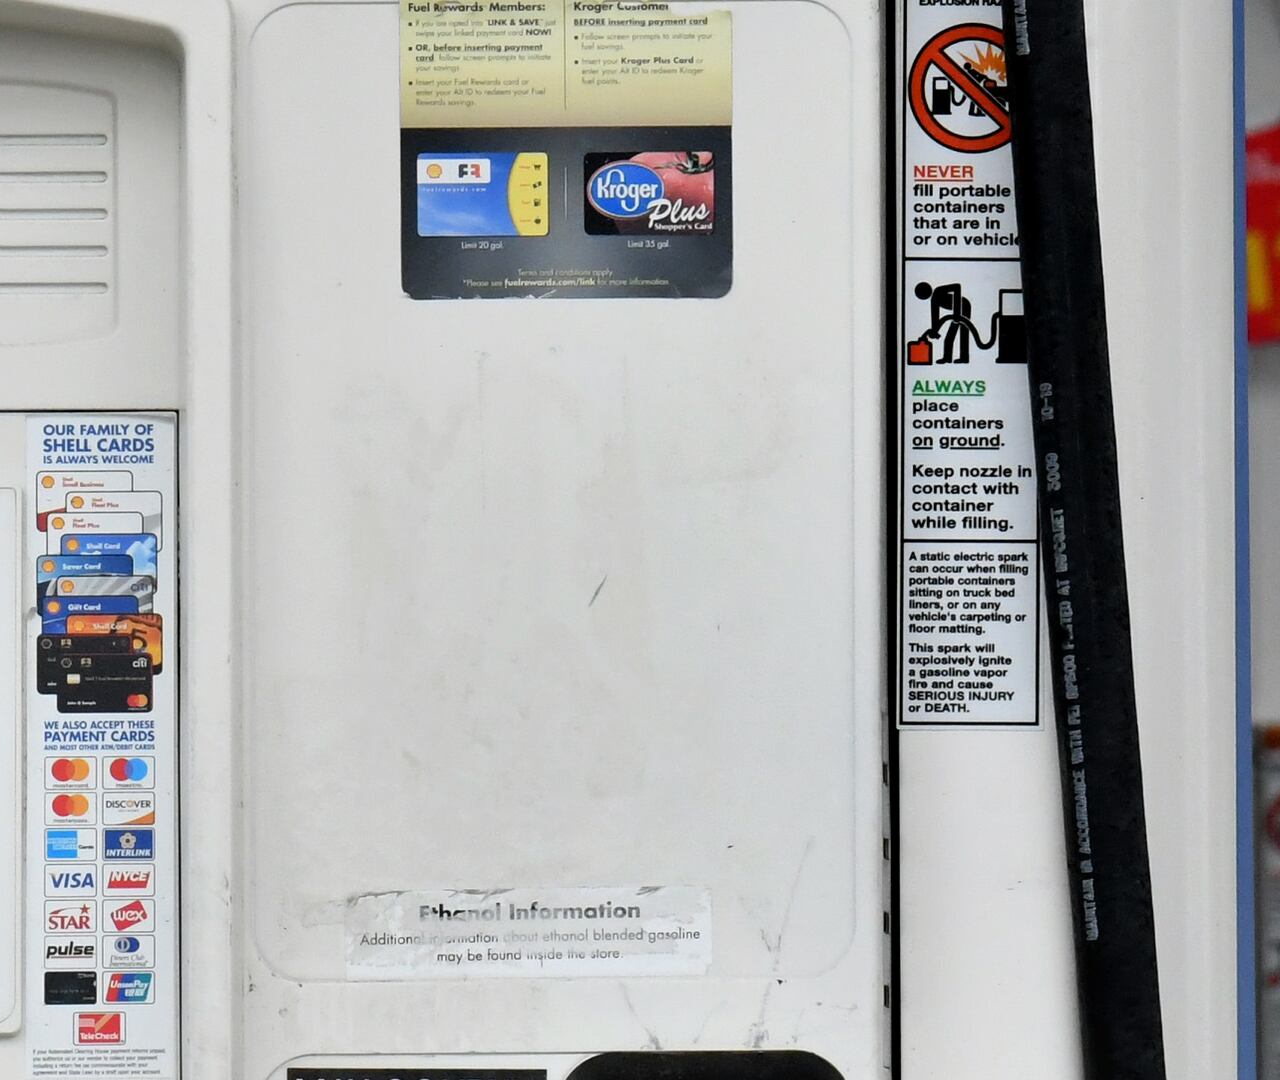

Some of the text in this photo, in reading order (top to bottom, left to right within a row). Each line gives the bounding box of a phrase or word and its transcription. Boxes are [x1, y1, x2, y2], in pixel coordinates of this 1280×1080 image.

[408, 1, 545, 12] Fuel Members:
[574, 2, 613, 12] Kroger
[526, 29, 551, 37] NOW!
[914, 166, 973, 178] NEVER
[597, 169, 658, 211] Kroger
[913, 184, 1011, 199] fill portable
[648, 198, 710, 228] Plus
[914, 201, 1005, 213] containers
[913, 217, 1000, 229] that are in
[914, 235, 931, 246] or
[937, 235, 957, 246] on
[912, 380, 985, 393] ALWAYS
[913, 399, 958, 414] place
[913, 417, 1003, 429] containers
[44, 424, 153, 435] OUR FAMILY OF
[44, 438, 154, 452] SHELL CARDS
[912, 435, 1005, 449] on ground.
[44, 455, 153, 464] IS ALWAYS WELCOME
[913, 465, 1032, 479] Keep nozzle in
[912, 482, 1018, 494] contact with
[912, 499, 994, 511] container
[912, 516, 1013, 532] while filling.
[909, 691, 1014, 701] SERIOUS INJURY
[925, 703, 969, 712] DEATH.
[44, 720, 154, 729] WE ALSO ACCEPT THESE
[45, 731, 155, 742] PAYMENT CARDS
[106, 800, 151, 809] DISCOVER
[106, 848, 152, 857] INTERLINK
[52, 872, 94, 888] VISA
[110, 870, 149, 882] NYCE
[510, 901, 640, 922] Information
[49, 915, 90, 930] STAR
[593, 928, 700, 944] blended gasoline
[46, 940, 94, 958] pulse
[437, 950, 483, 965] may be
[79, 1032, 119, 1040] TeleCheck
